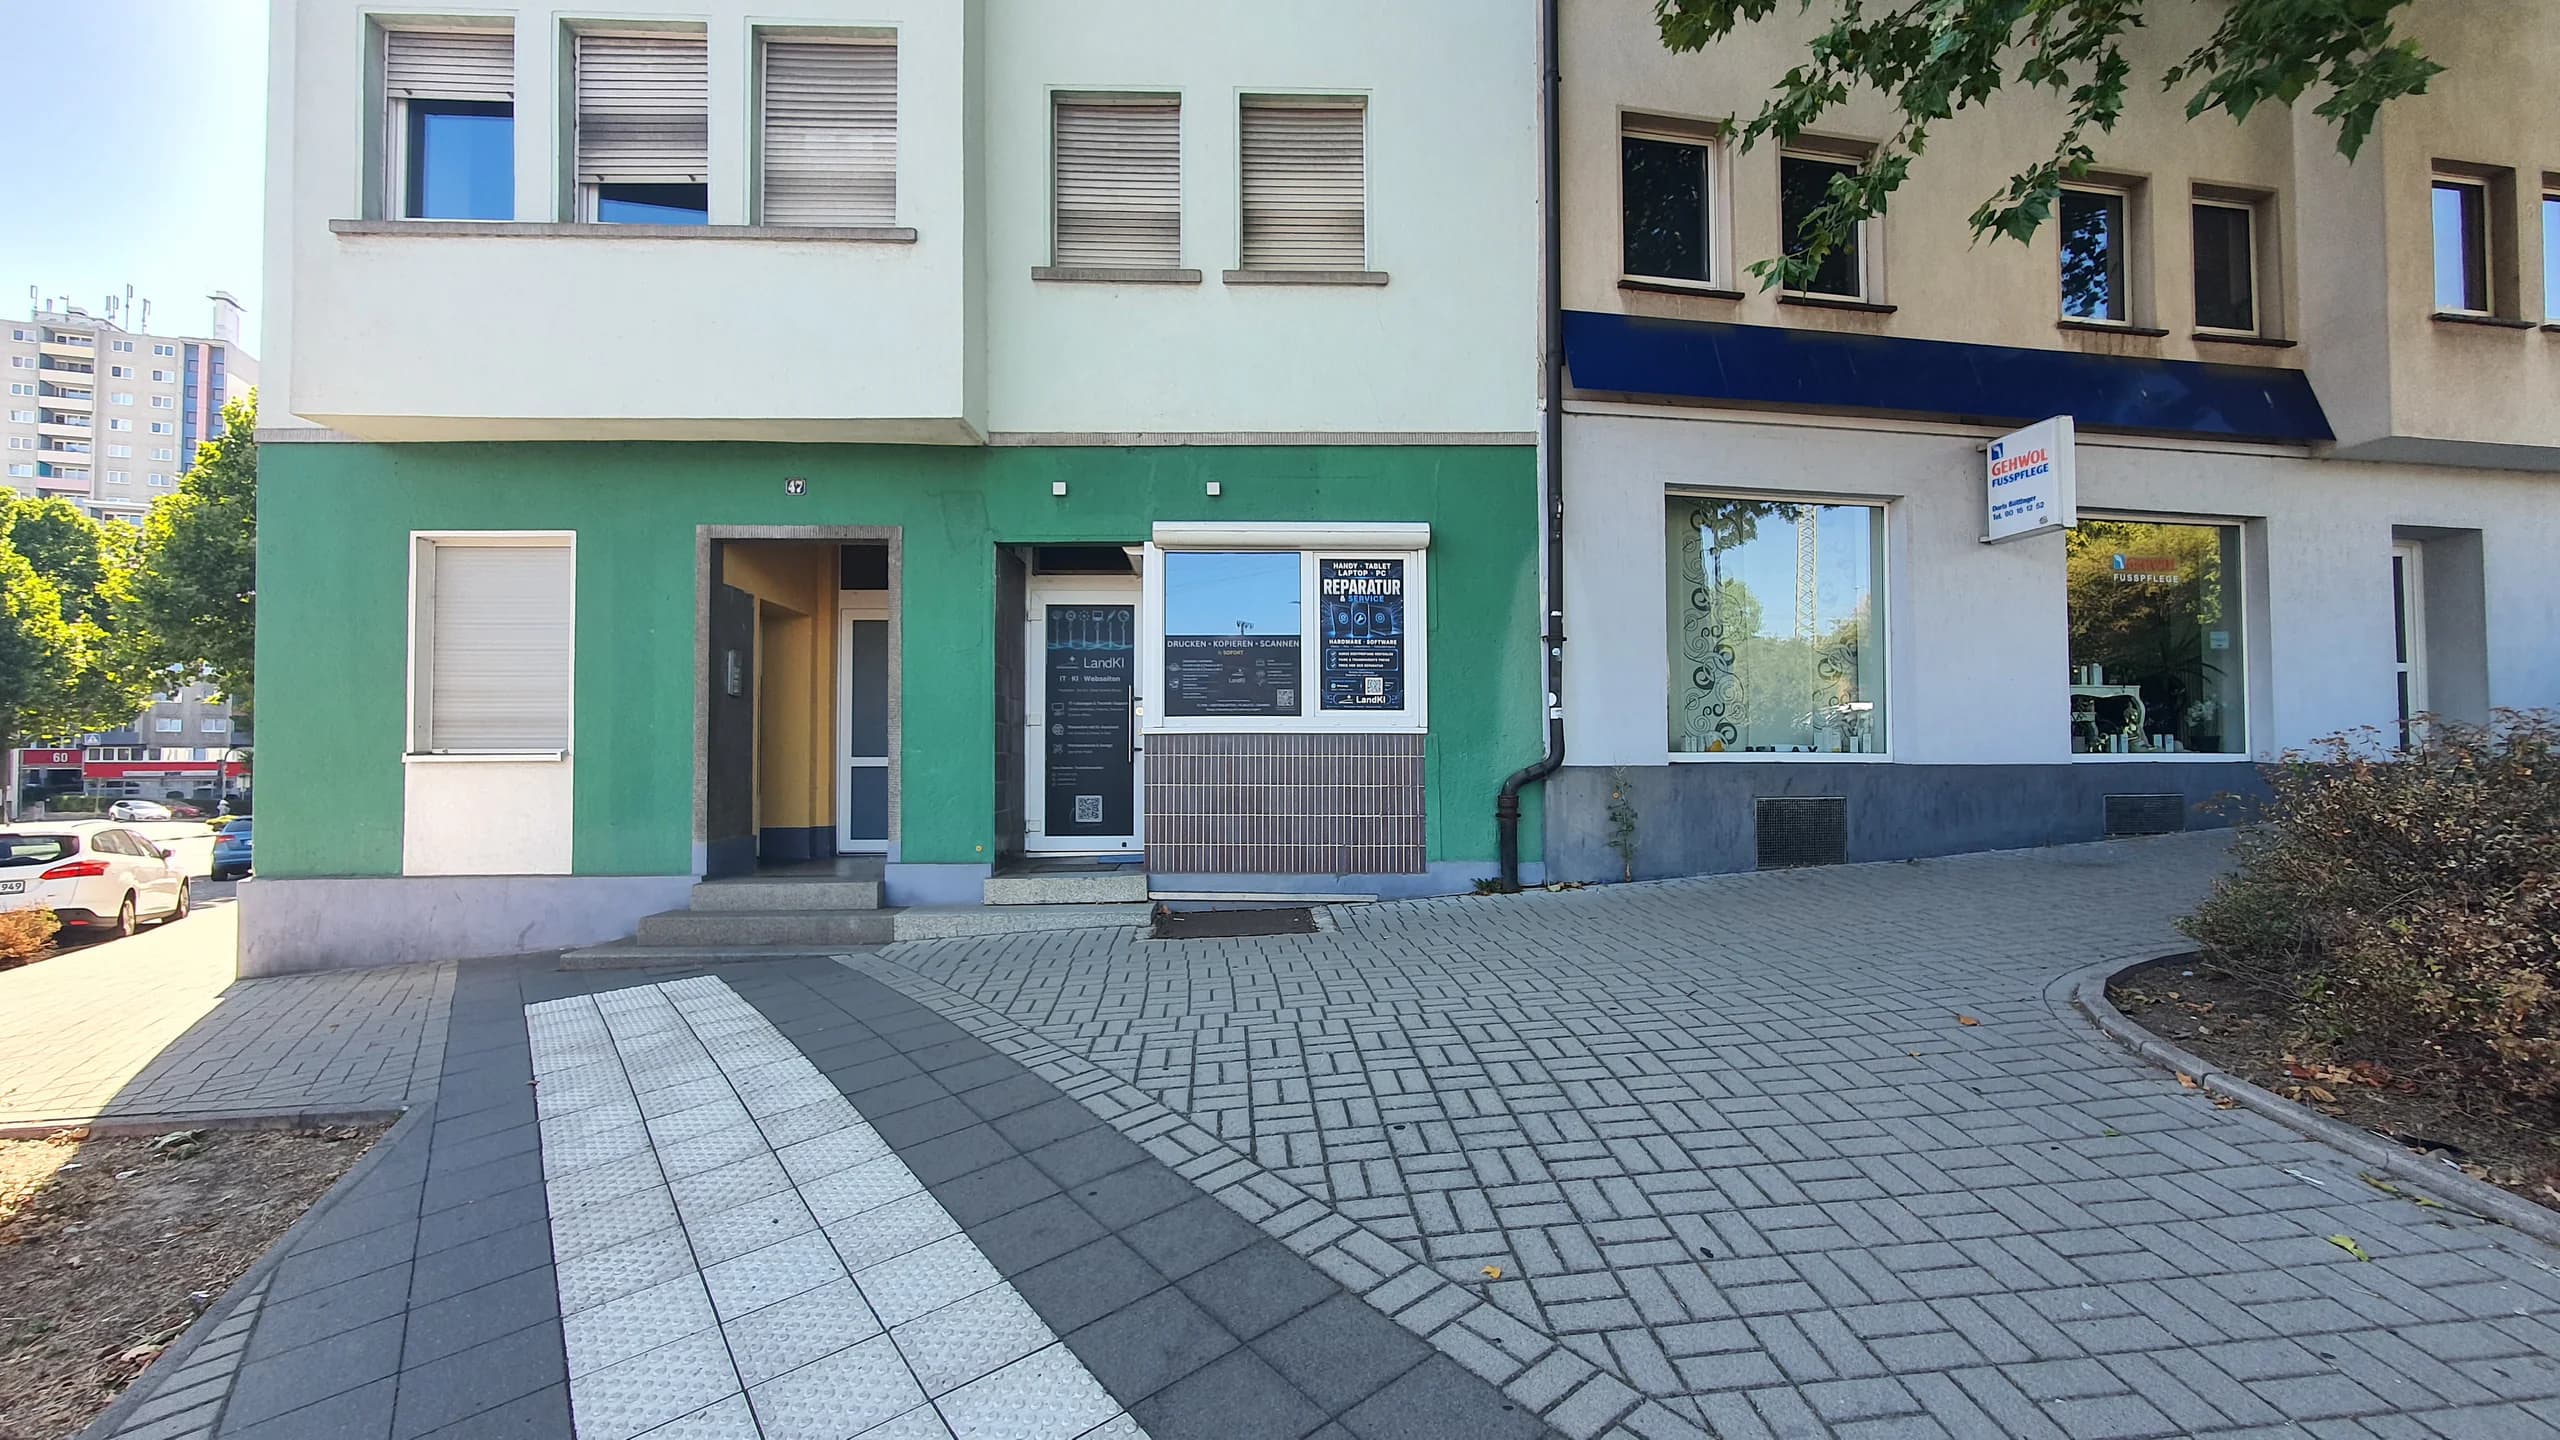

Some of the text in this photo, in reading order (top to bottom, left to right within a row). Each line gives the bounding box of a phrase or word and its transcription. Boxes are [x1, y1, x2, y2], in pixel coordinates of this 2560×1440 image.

[1992, 448, 2048, 477] GEHWOL
[1992, 463, 2049, 488] FUSSPFLEGE
[788, 480, 803, 493] 47
[1333, 562, 1391, 570] HANDY TABLET
[2113, 573, 2180, 583] FUSSPFLEGE
[1323, 579, 1401, 595] REPARATUR
[1348, 595, 1385, 603] SERVICE
[1167, 640, 1300, 648] DRUCKEN KOPIEREN SCANNEN
[1083, 657, 1125, 669] LandKI
[1356, 696, 1386, 704] LandKI
[52, 752, 68, 763] 60
[1, 882, 22, 891] 949
